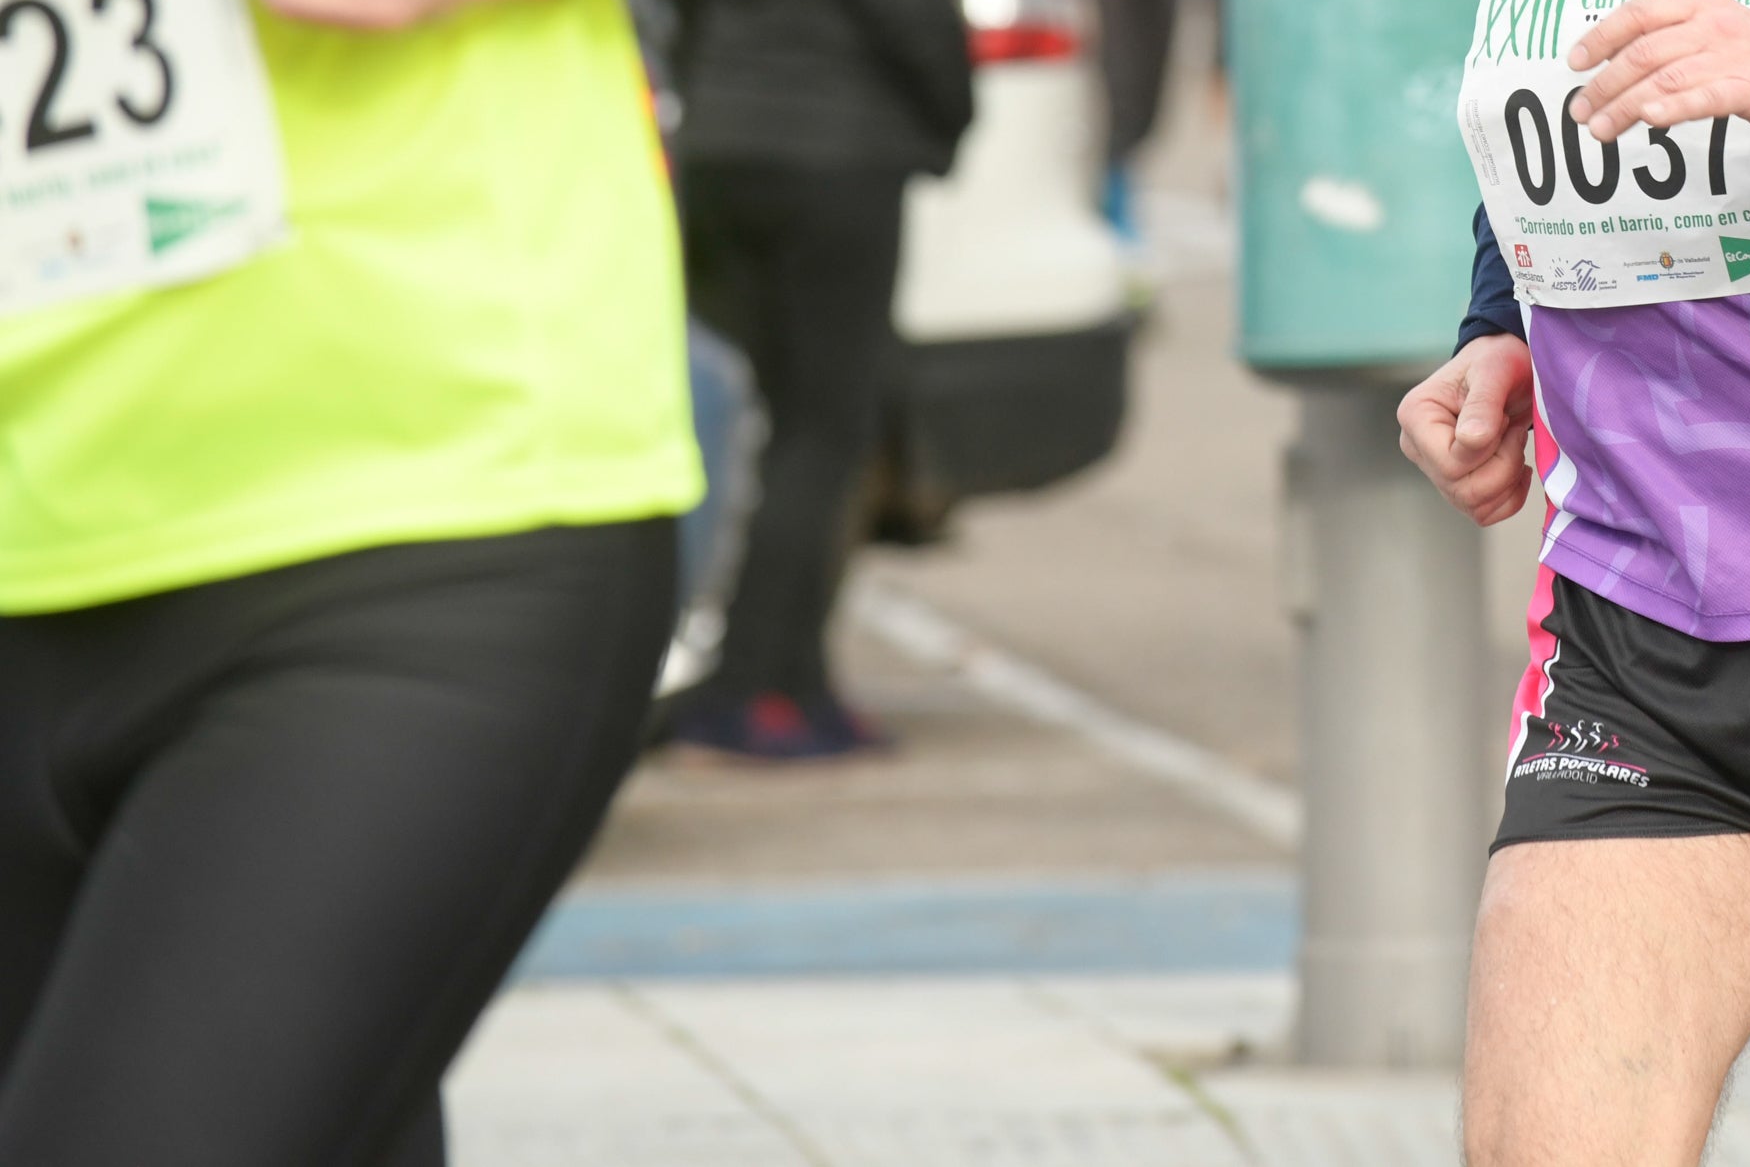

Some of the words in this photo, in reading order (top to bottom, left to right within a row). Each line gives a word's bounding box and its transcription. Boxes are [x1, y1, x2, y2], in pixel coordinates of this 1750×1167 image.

[1503, 85, 1730, 207] 0037
[1579, 221, 1596, 235] en
[1601, 217, 1614, 234] el
[1620, 214, 1669, 233] barrio,
[1674, 215, 1713, 230] como
[1718, 211, 1738, 226] en
[1636, 274, 1659, 282] FMD
[1514, 757, 1557, 779] ATLETAS
[1558, 757, 1651, 788] POPULARES
